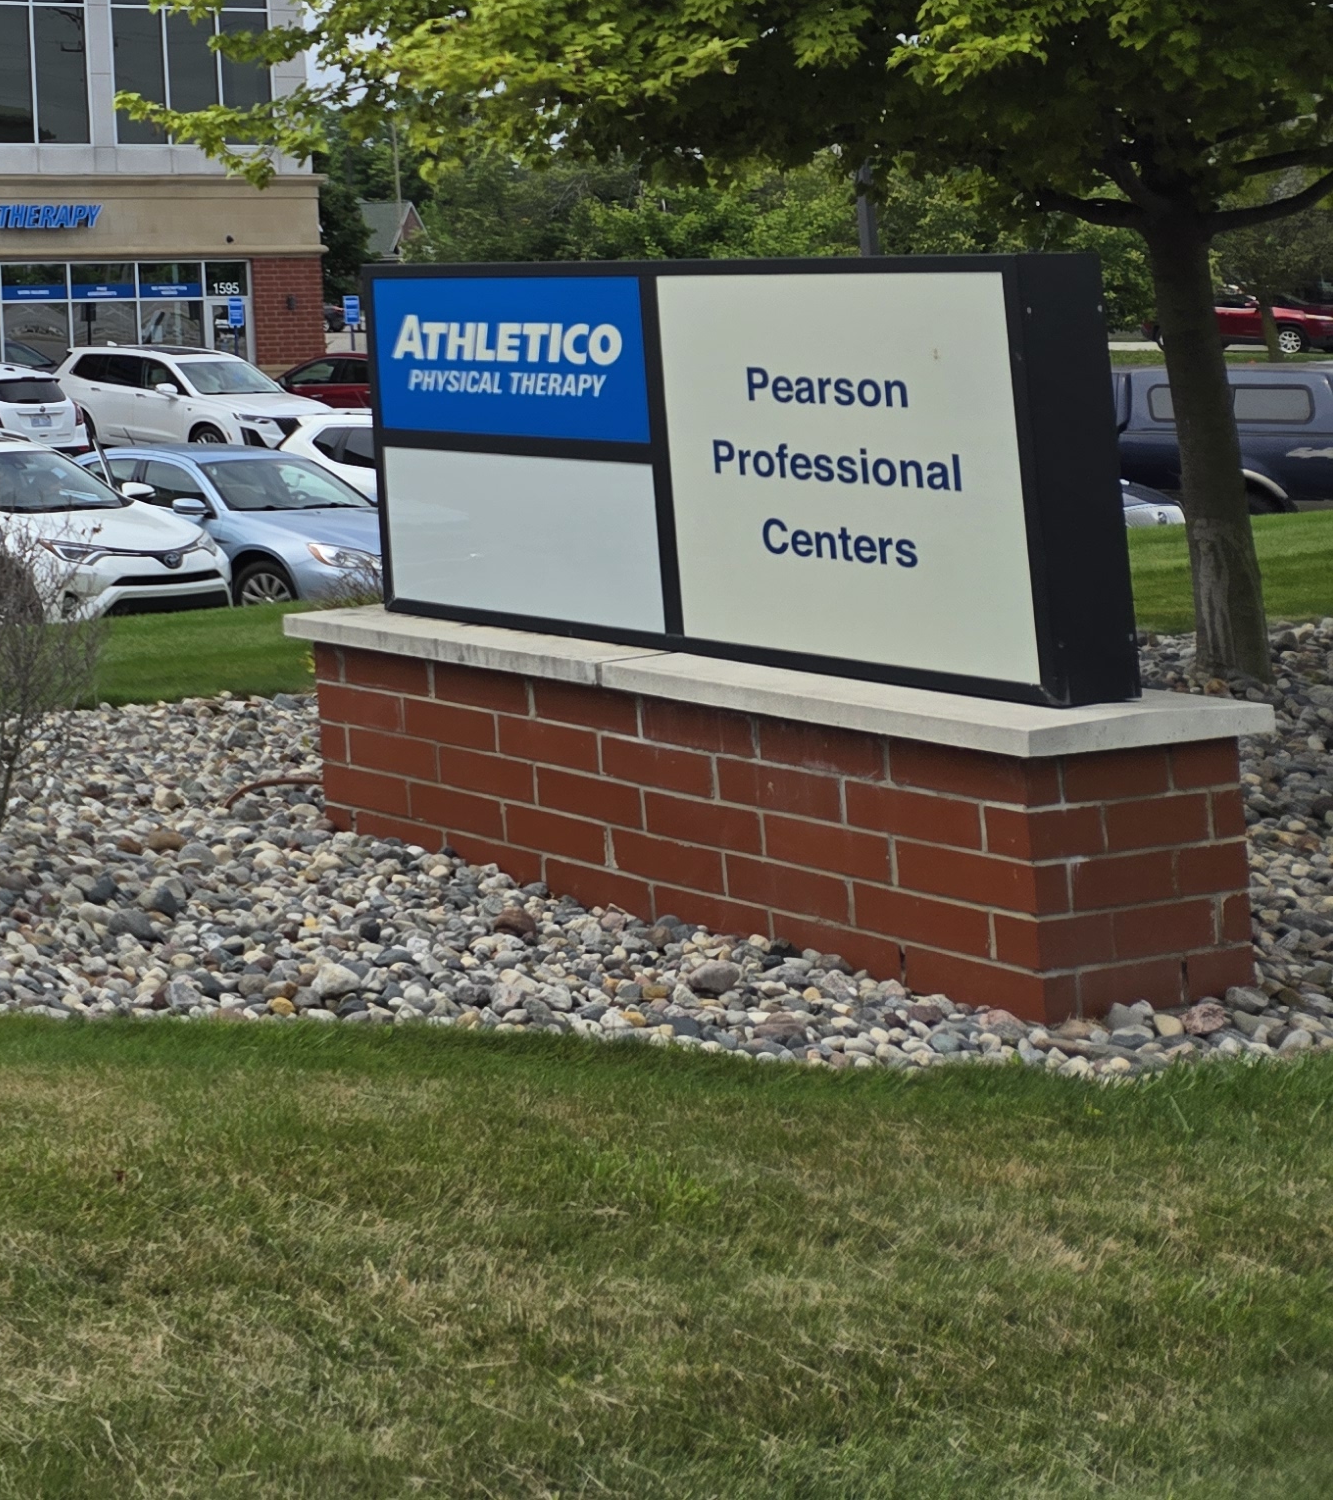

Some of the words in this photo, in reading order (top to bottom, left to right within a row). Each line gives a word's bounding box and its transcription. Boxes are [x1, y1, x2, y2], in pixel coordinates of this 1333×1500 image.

[213, 282, 240, 295] 1595
[391, 314, 623, 366] ATHLETICO
[407, 369, 503, 395] PHYSICAL
[509, 371, 607, 398] THERAPY
[746, 366, 909, 408] Pearson
[712, 439, 962, 492] Professional
[762, 517, 919, 568] Centers
